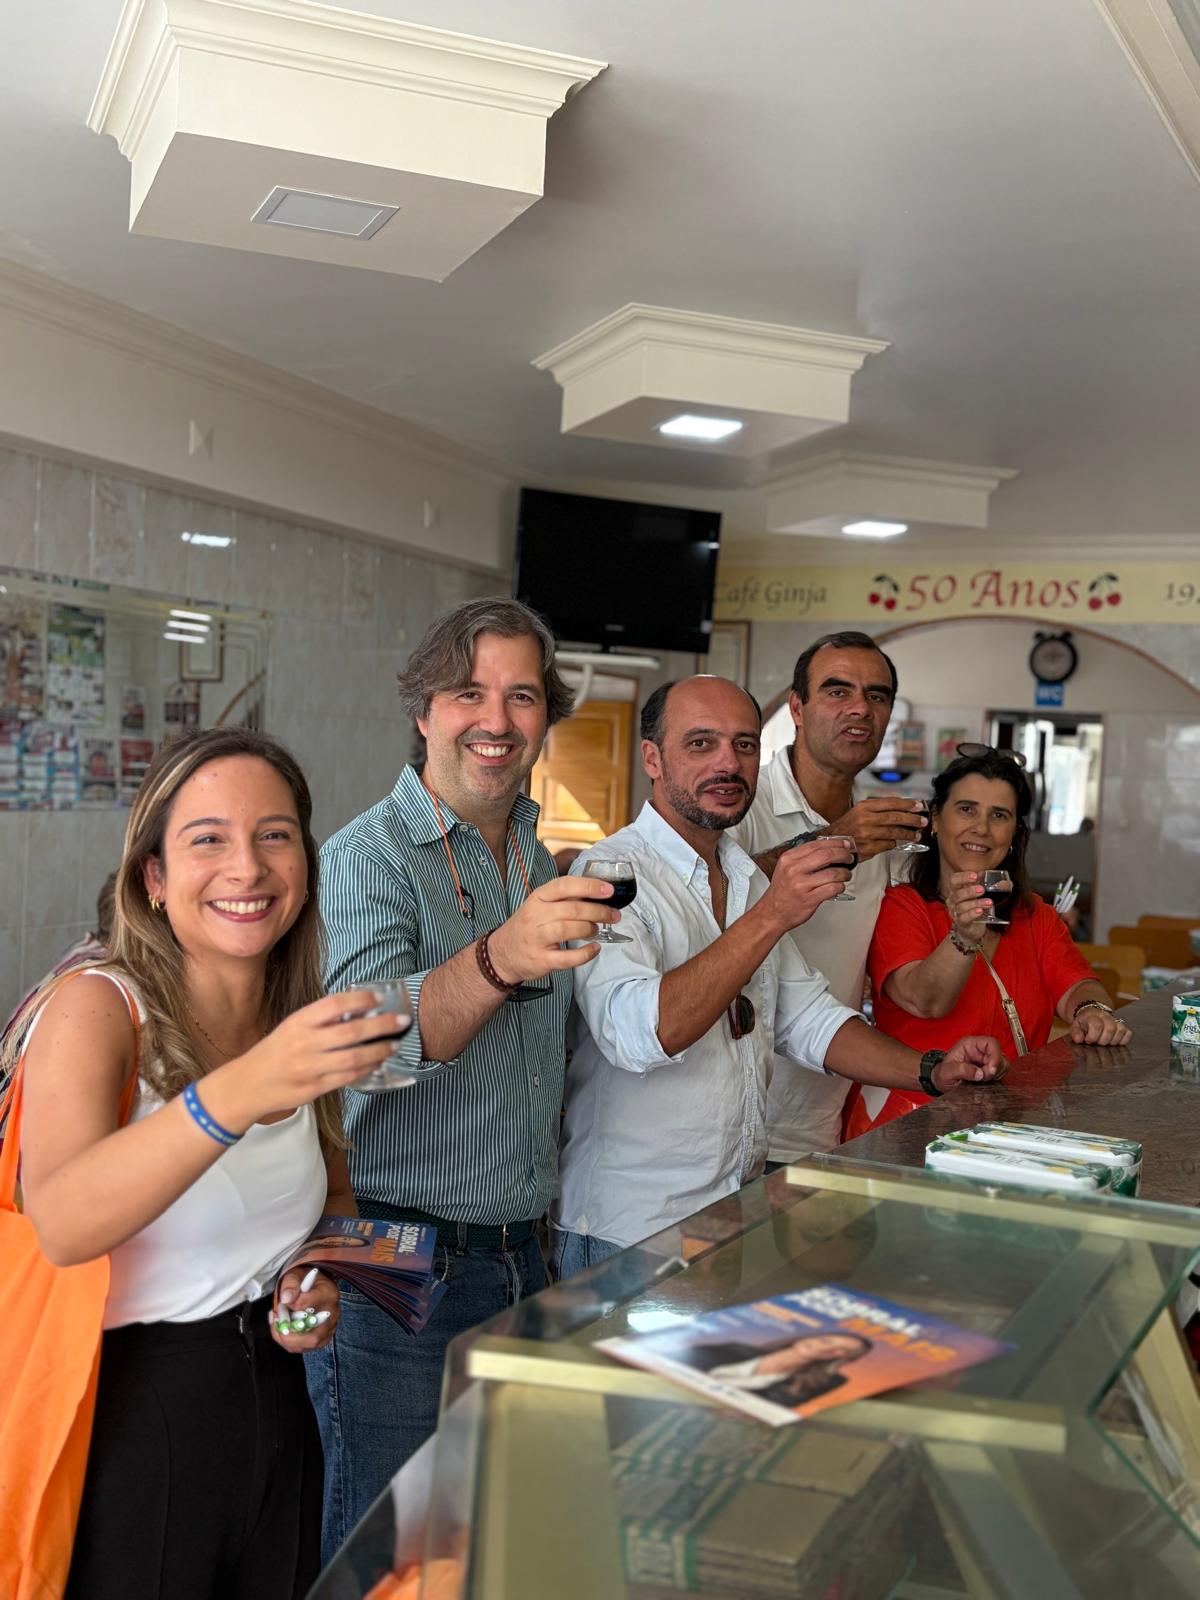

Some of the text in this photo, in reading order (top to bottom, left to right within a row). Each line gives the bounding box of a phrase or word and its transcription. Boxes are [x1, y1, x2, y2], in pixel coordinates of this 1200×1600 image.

[764, 579, 827, 615] Ginja
[905, 569, 1080, 611] 50 Anos
[1163, 582, 1200, 608] 19
[1037, 685, 1064, 702] WC
[368, 1237, 398, 1264] MAIS
[398, 1225, 420, 1253] SOBRAL
